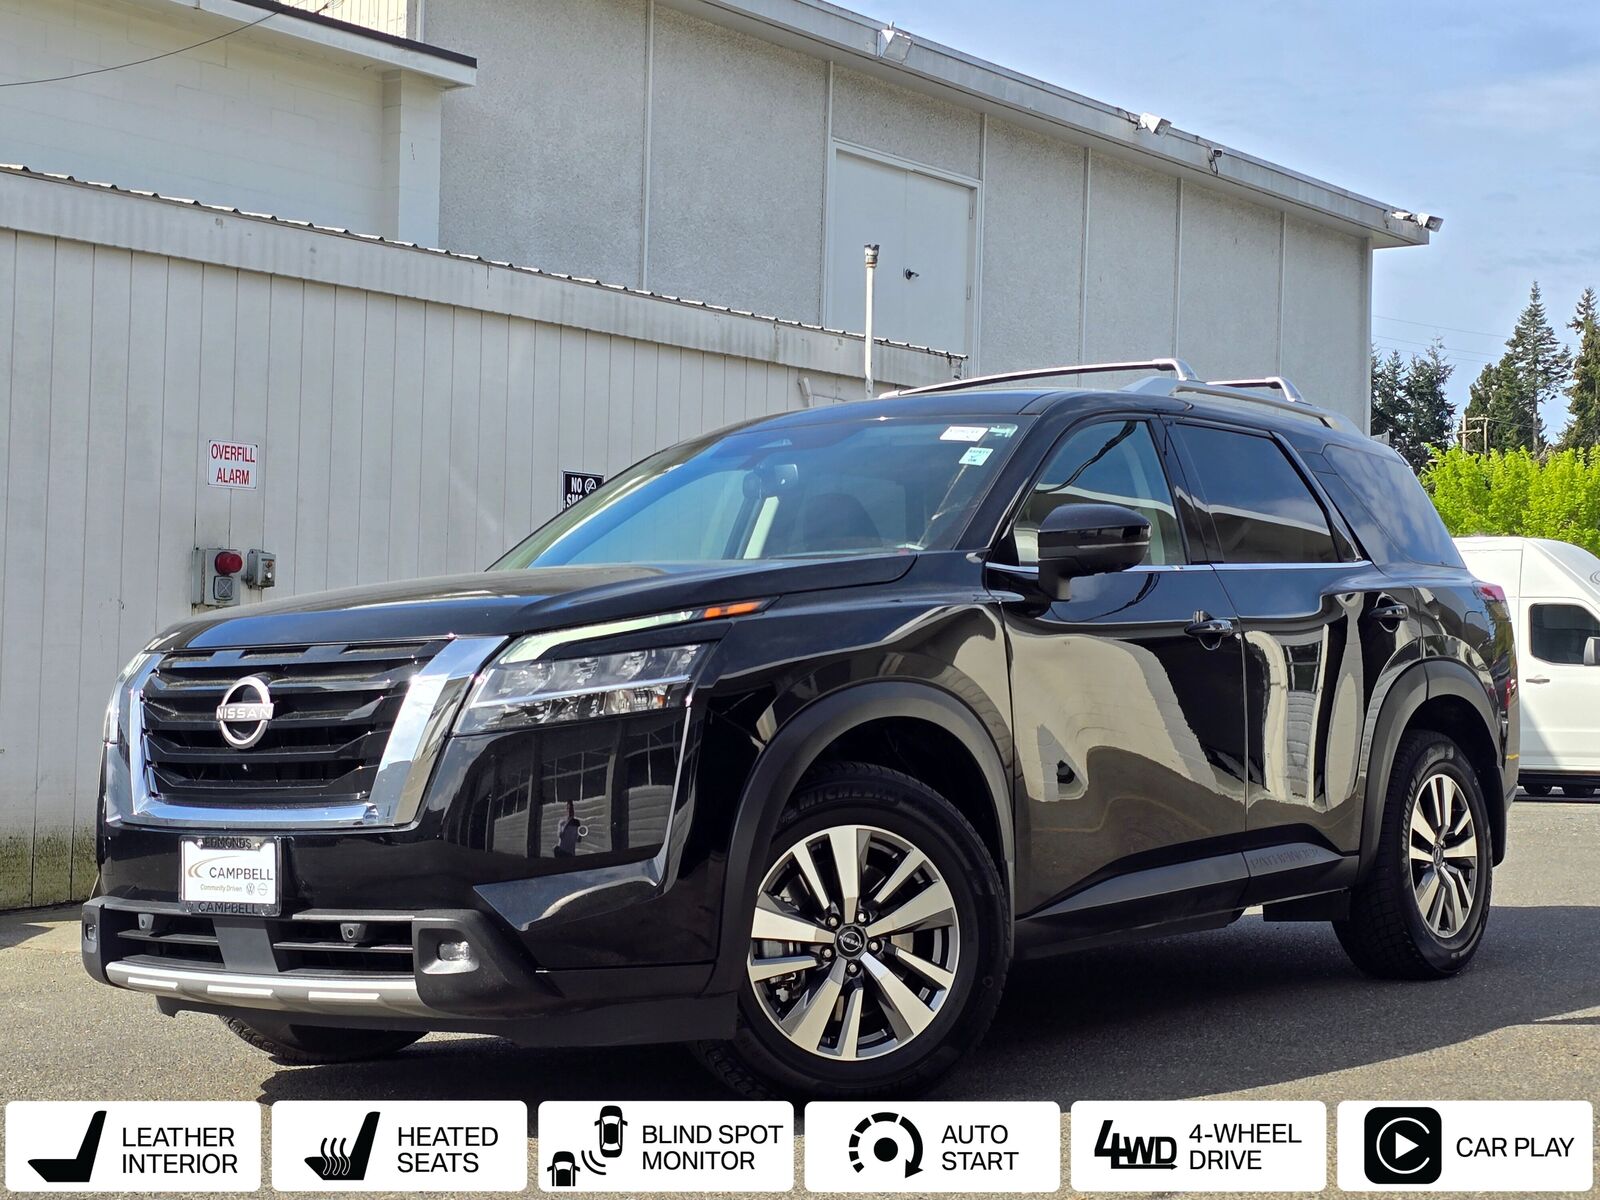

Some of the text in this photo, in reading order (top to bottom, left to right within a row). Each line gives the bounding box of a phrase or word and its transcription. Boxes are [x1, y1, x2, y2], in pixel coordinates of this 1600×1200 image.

[210, 443, 256, 463] OVERFILL
[216, 467, 250, 485] ALARM
[571, 477, 583, 493] NO
[216, 706, 271, 720] NISSAN
[204, 836, 252, 849] EDMONDS
[209, 866, 274, 881] CAMPBELL
[200, 883, 243, 893] Community Driven
[198, 902, 258, 915] CAMPBELL
